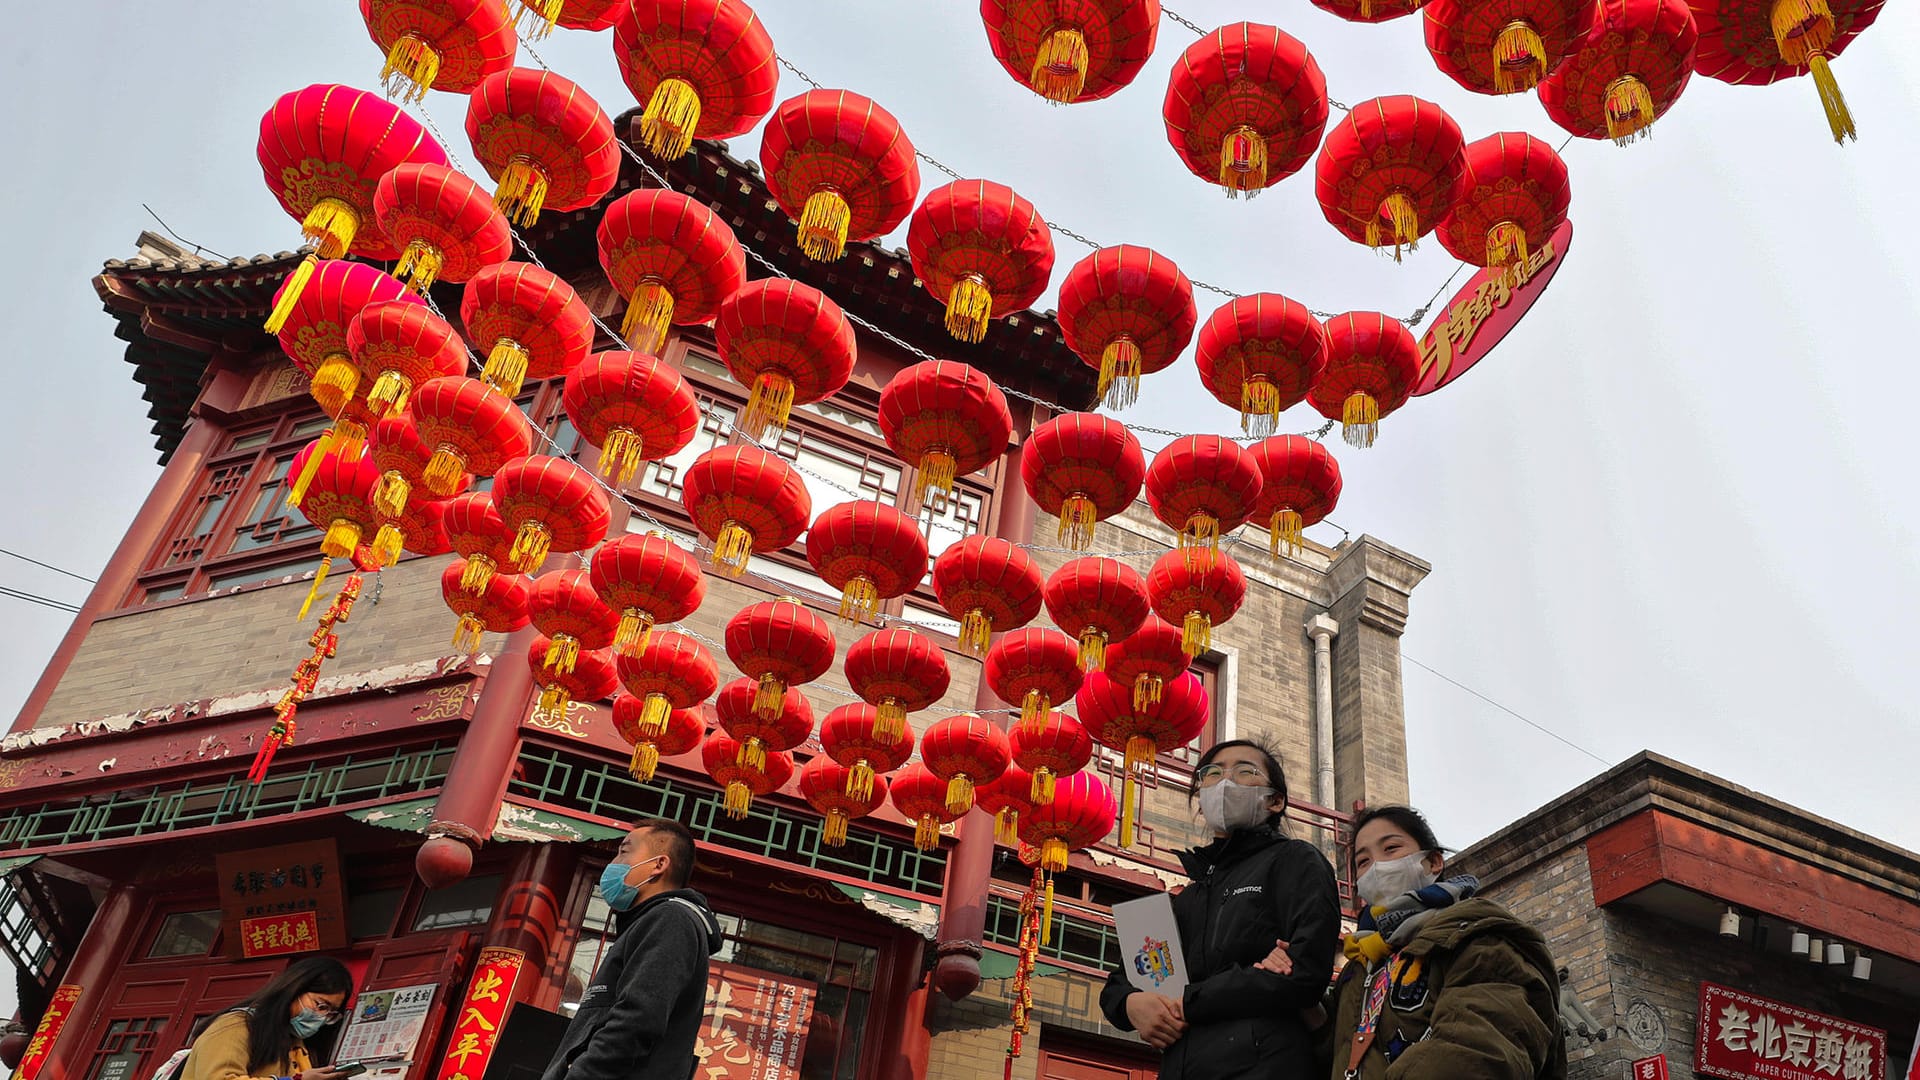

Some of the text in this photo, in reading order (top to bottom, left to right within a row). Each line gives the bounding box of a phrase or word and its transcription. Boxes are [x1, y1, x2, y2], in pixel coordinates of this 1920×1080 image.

[249, 920, 313, 950] 吉星高照
[447, 968, 504, 1080] 出入平
[1754, 1062, 1780, 1077] PAPER
